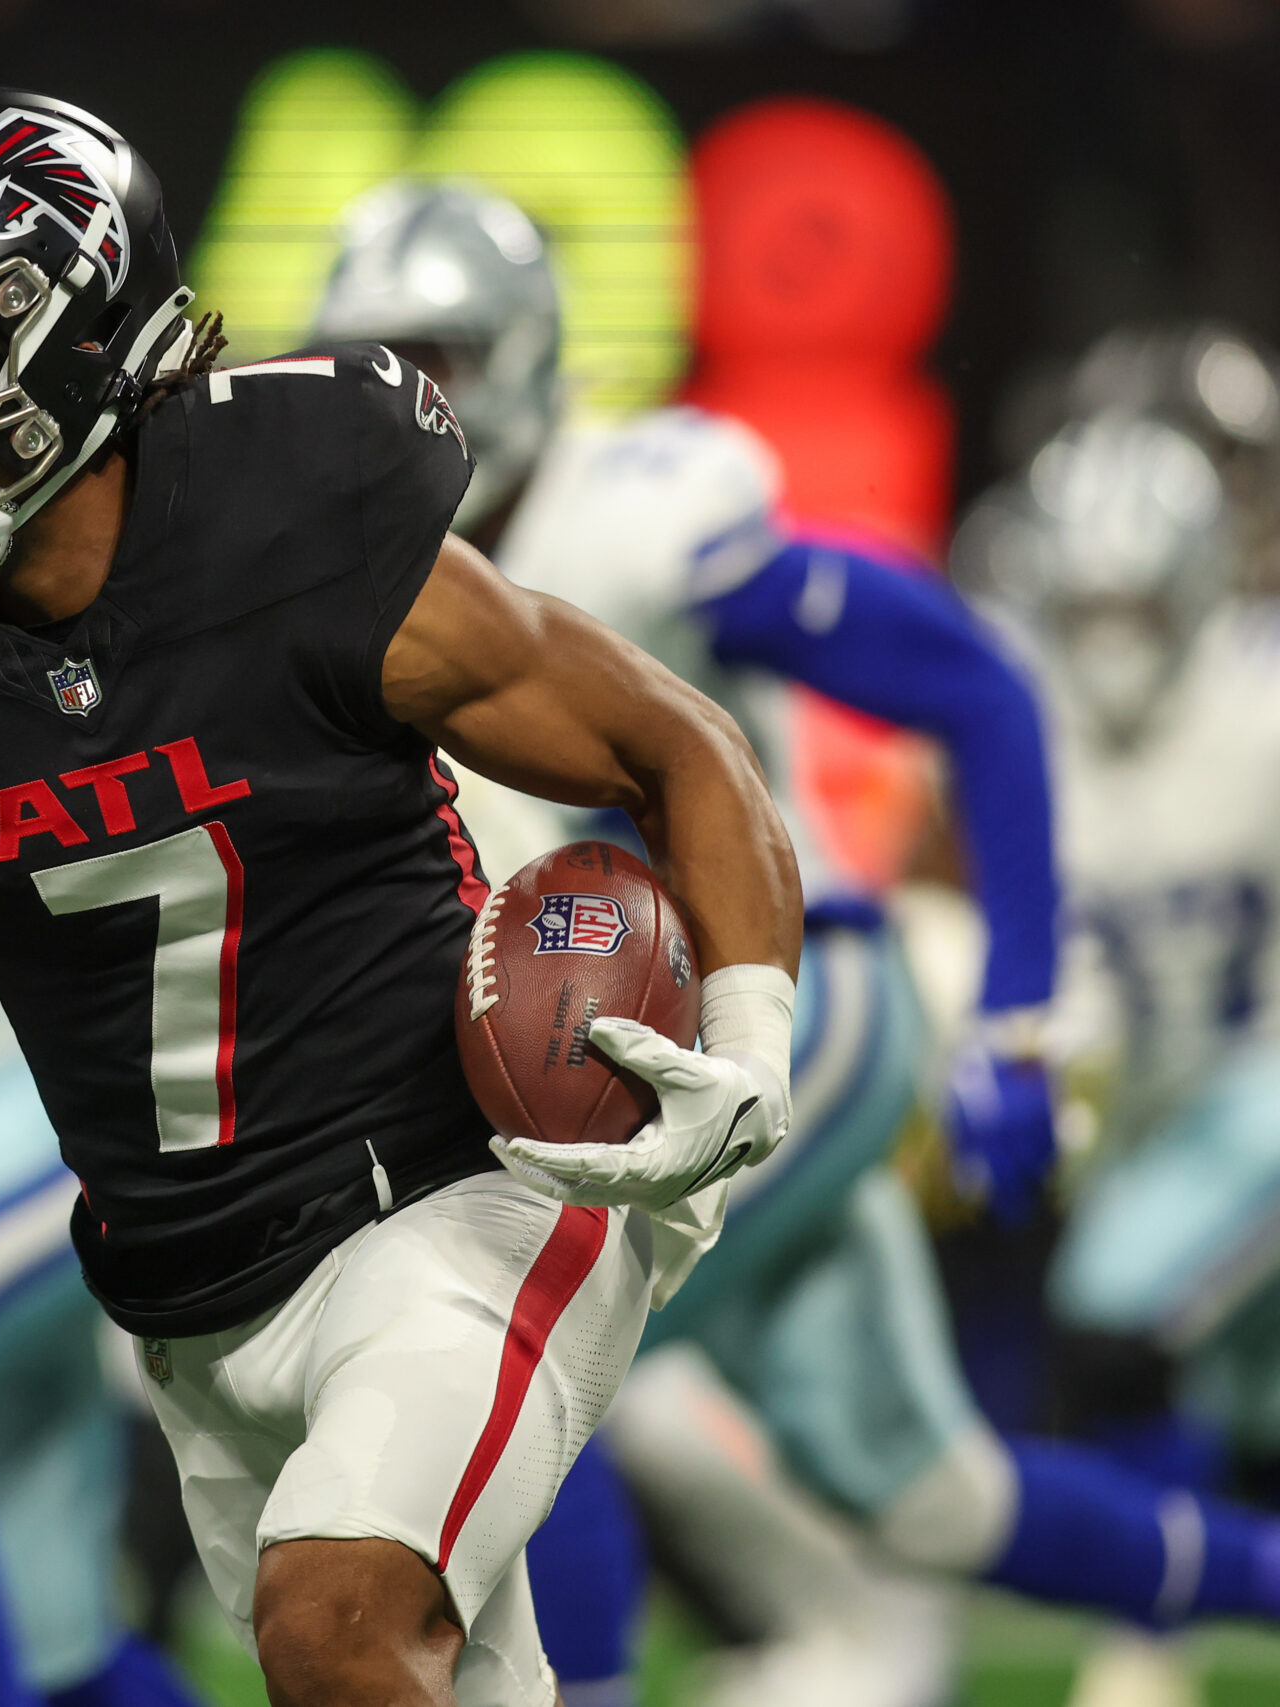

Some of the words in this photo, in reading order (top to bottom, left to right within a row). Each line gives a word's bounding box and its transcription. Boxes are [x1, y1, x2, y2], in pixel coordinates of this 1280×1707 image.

[61, 682, 95, 707] NFL
[572, 901, 619, 948] NFL
[31, 821, 244, 1152] 7
